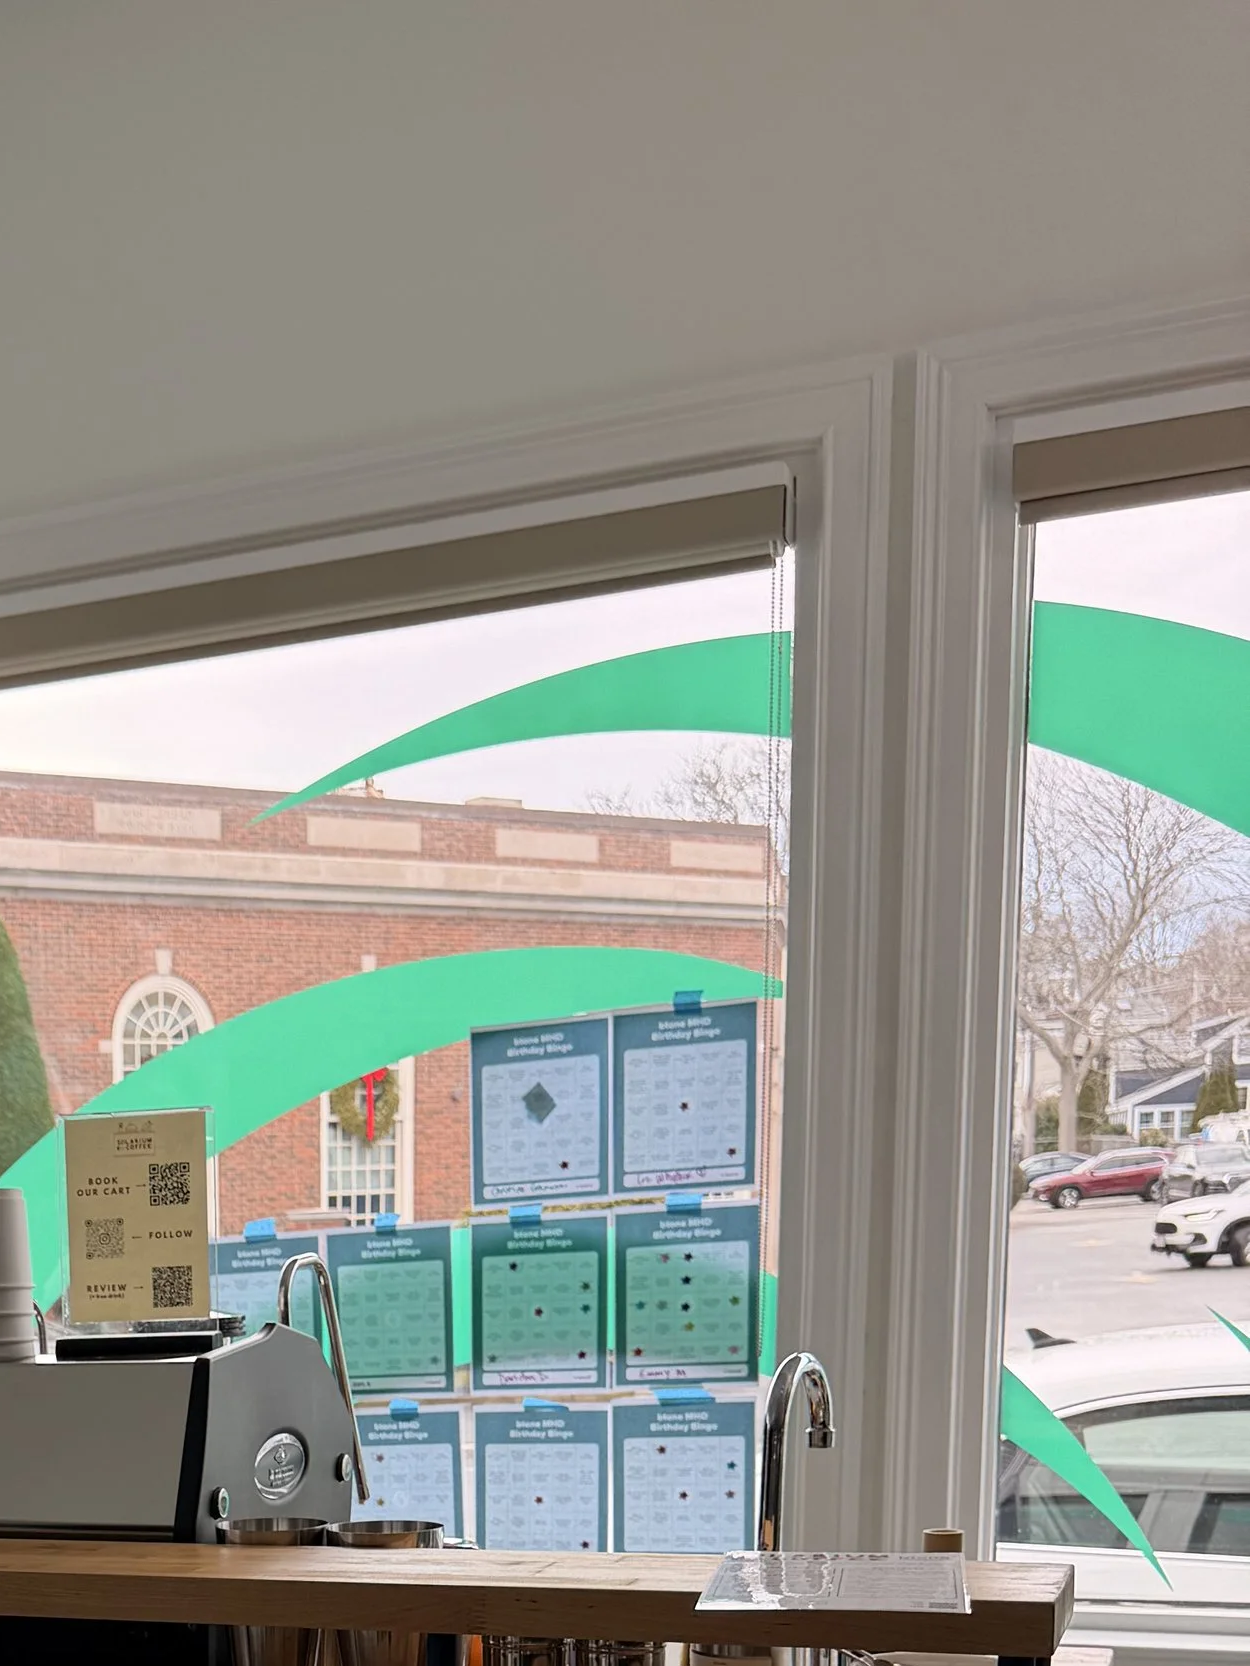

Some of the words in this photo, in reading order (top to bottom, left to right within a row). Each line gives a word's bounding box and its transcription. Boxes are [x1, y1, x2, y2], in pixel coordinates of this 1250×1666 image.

[88, 1177, 118, 1186] BOOK
[76, 1188, 99, 1197] OUR
[103, 1186, 131, 1196] CART
[148, 1230, 193, 1240] FOLLOW
[86, 1283, 127, 1293] REVIEW
